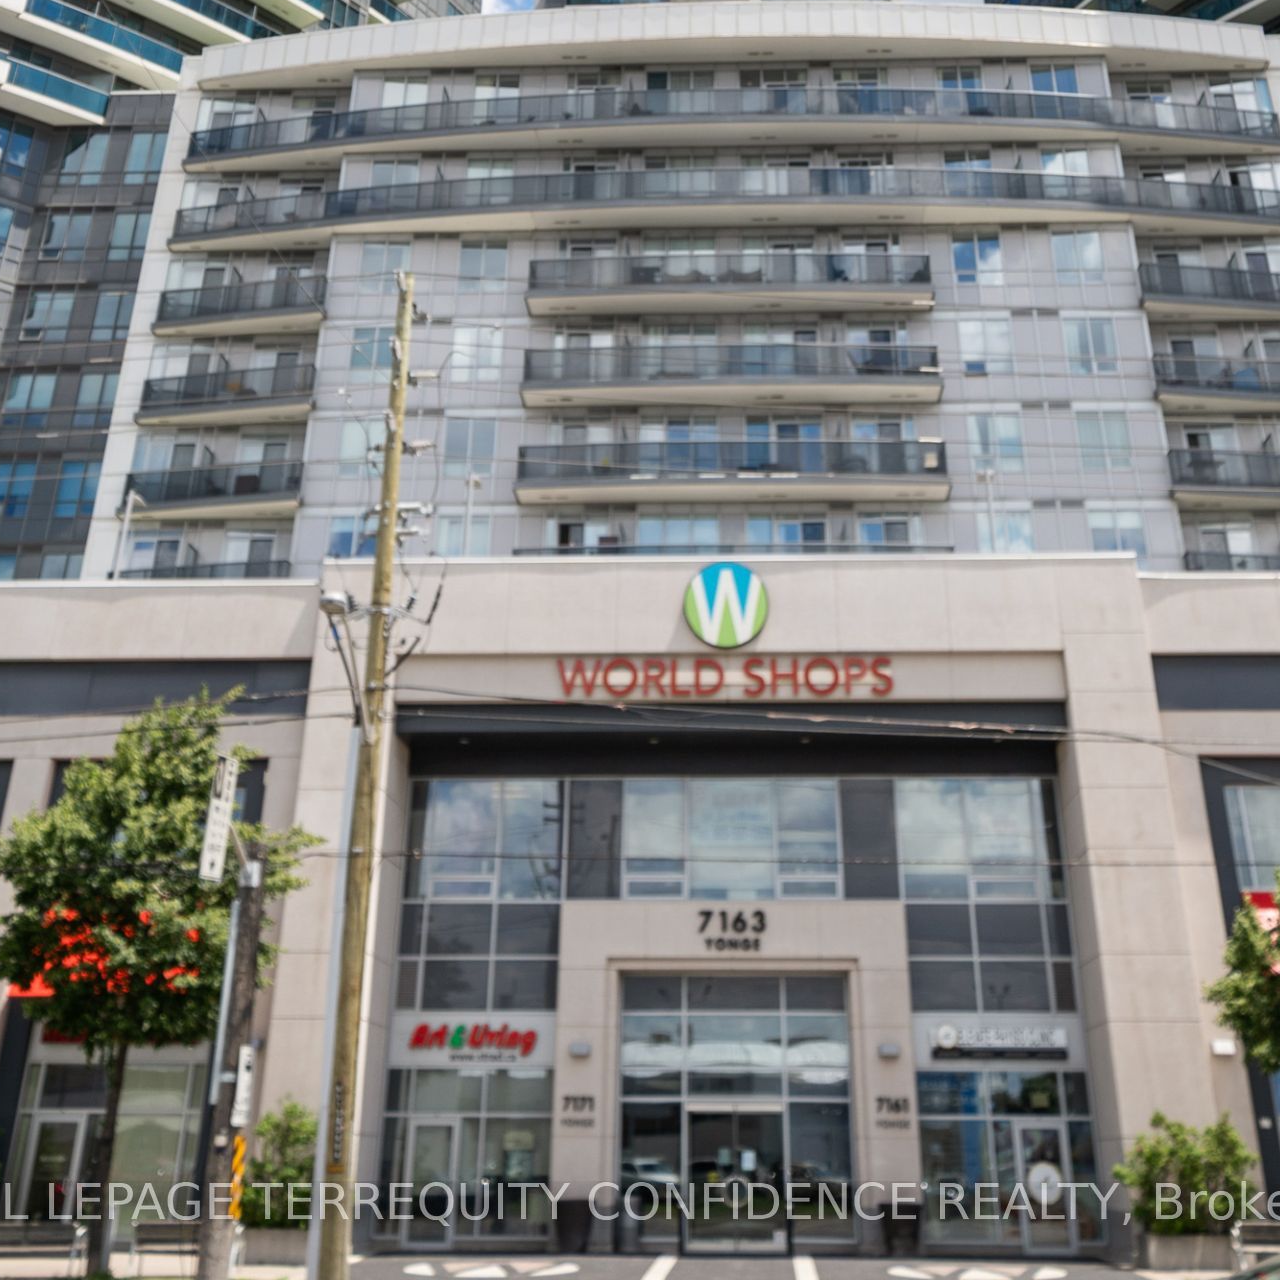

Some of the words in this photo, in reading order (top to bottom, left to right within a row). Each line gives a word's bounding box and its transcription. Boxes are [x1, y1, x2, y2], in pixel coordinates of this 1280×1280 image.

[556, 657, 724, 698] WORLD
[742, 657, 894, 698] SHOPS
[697, 909, 767, 934] 7163
[704, 938, 761, 952] YONGE
[408, 1024, 448, 1050] Art
[449, 1024, 466, 1049] &
[562, 1095, 594, 1112] 7171
[875, 1096, 910, 1113] 7161
